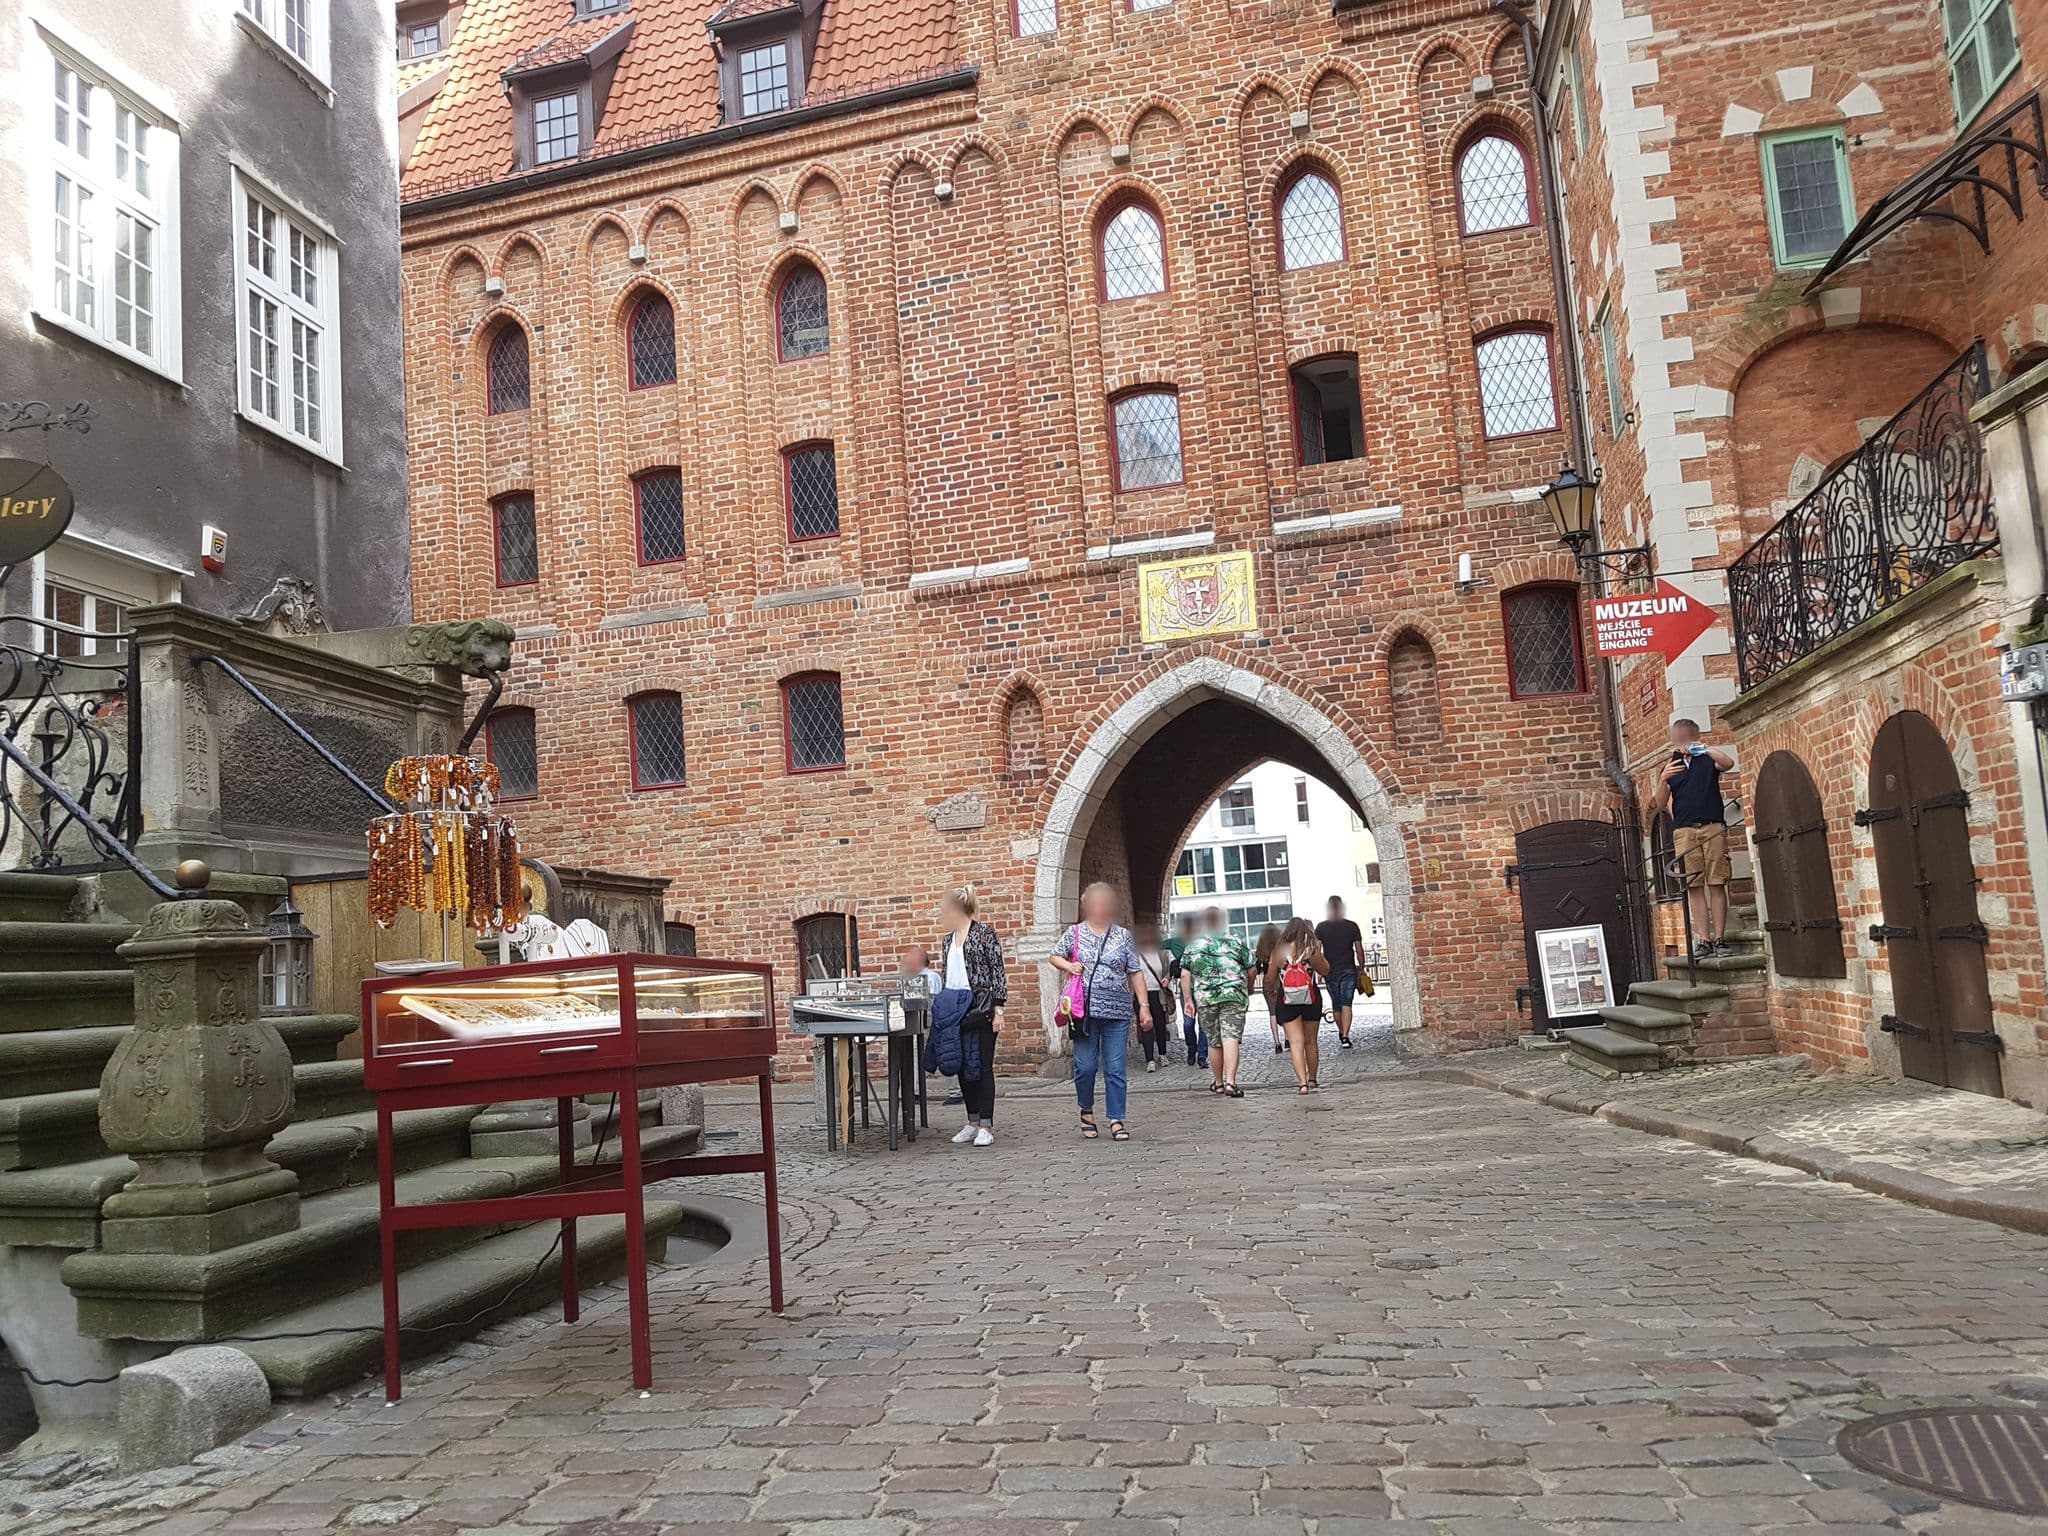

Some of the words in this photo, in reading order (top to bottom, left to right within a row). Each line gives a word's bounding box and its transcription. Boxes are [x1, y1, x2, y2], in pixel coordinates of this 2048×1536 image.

[1, 497, 56, 518] lery
[1595, 596, 1688, 620] MUZEUM
[1597, 619, 1641, 632] WEJŚCIE
[1598, 627, 1654, 641] ENTRANCE
[1599, 638, 1648, 651] EINGANG
